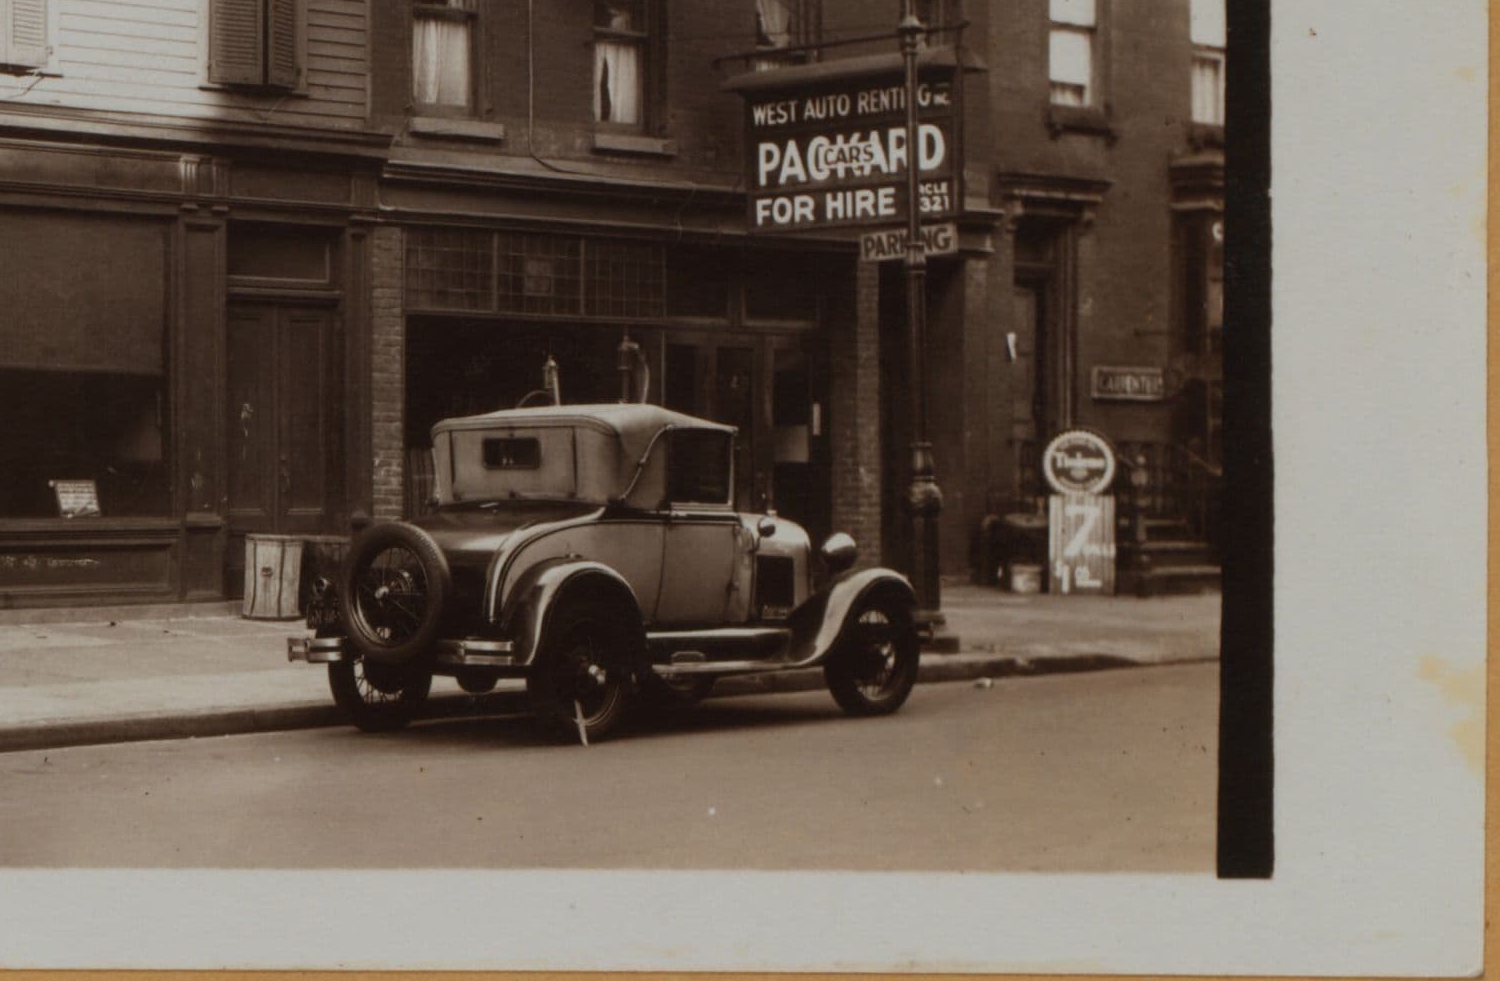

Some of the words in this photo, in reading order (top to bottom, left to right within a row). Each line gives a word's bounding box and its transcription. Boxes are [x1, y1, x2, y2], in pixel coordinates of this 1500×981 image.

[752, 99, 798, 126] WEST
[803, 93, 850, 120] AUTO
[857, 83, 932, 115] RENTIG
[758, 123, 946, 187] PACKARD
[824, 142, 875, 166] CARS
[755, 194, 815, 226] FOR
[825, 186, 897, 221] HIRE
[862, 226, 952, 258] PARKNG
